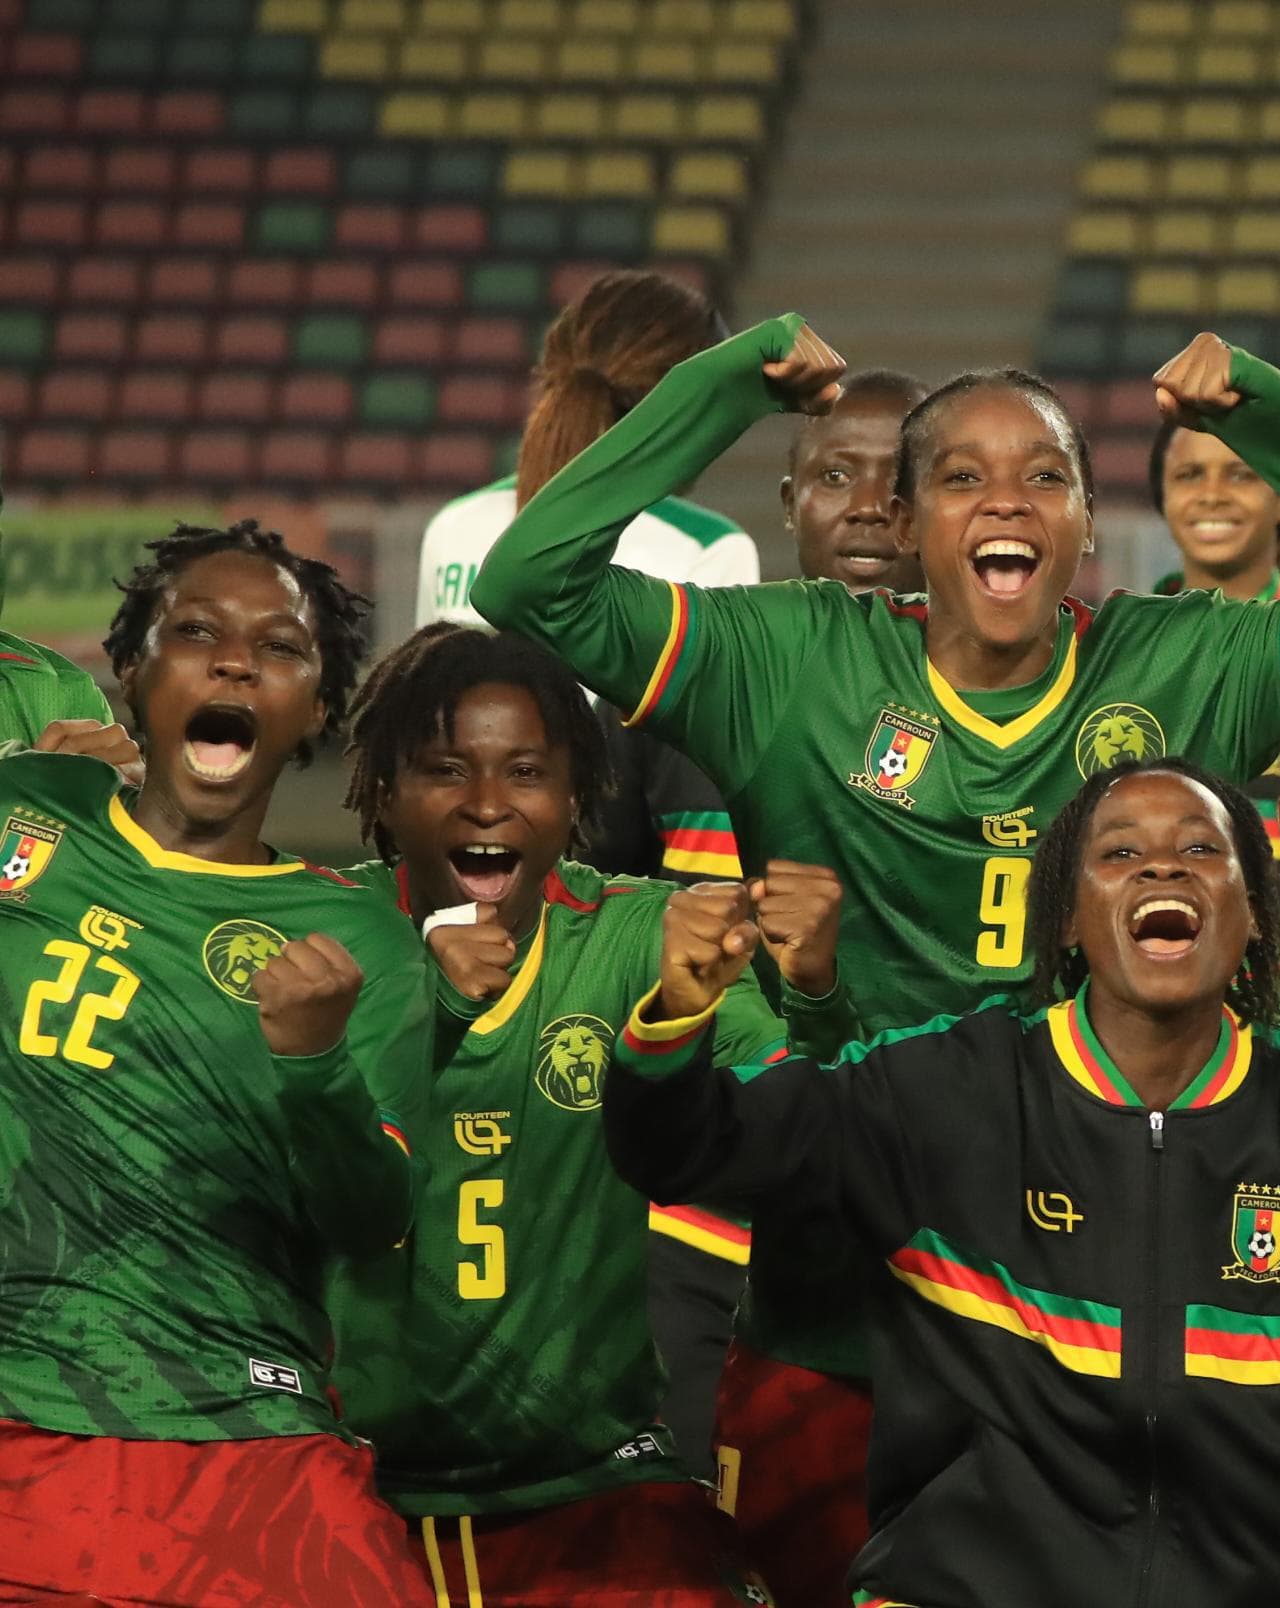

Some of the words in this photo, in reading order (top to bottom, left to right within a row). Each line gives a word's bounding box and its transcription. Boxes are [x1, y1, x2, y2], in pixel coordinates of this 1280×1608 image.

[885, 714, 931, 739] CAMEROUN
[864, 779, 903, 798] FECAFOOT
[983, 805, 1034, 822] FOURTEEN
[10, 822, 56, 841] CAMEROUN
[976, 857, 1031, 968] 9
[20, 939, 141, 1069] 22
[454, 1111, 511, 1120] FOURTEEN
[458, 1179, 505, 1300] 5
